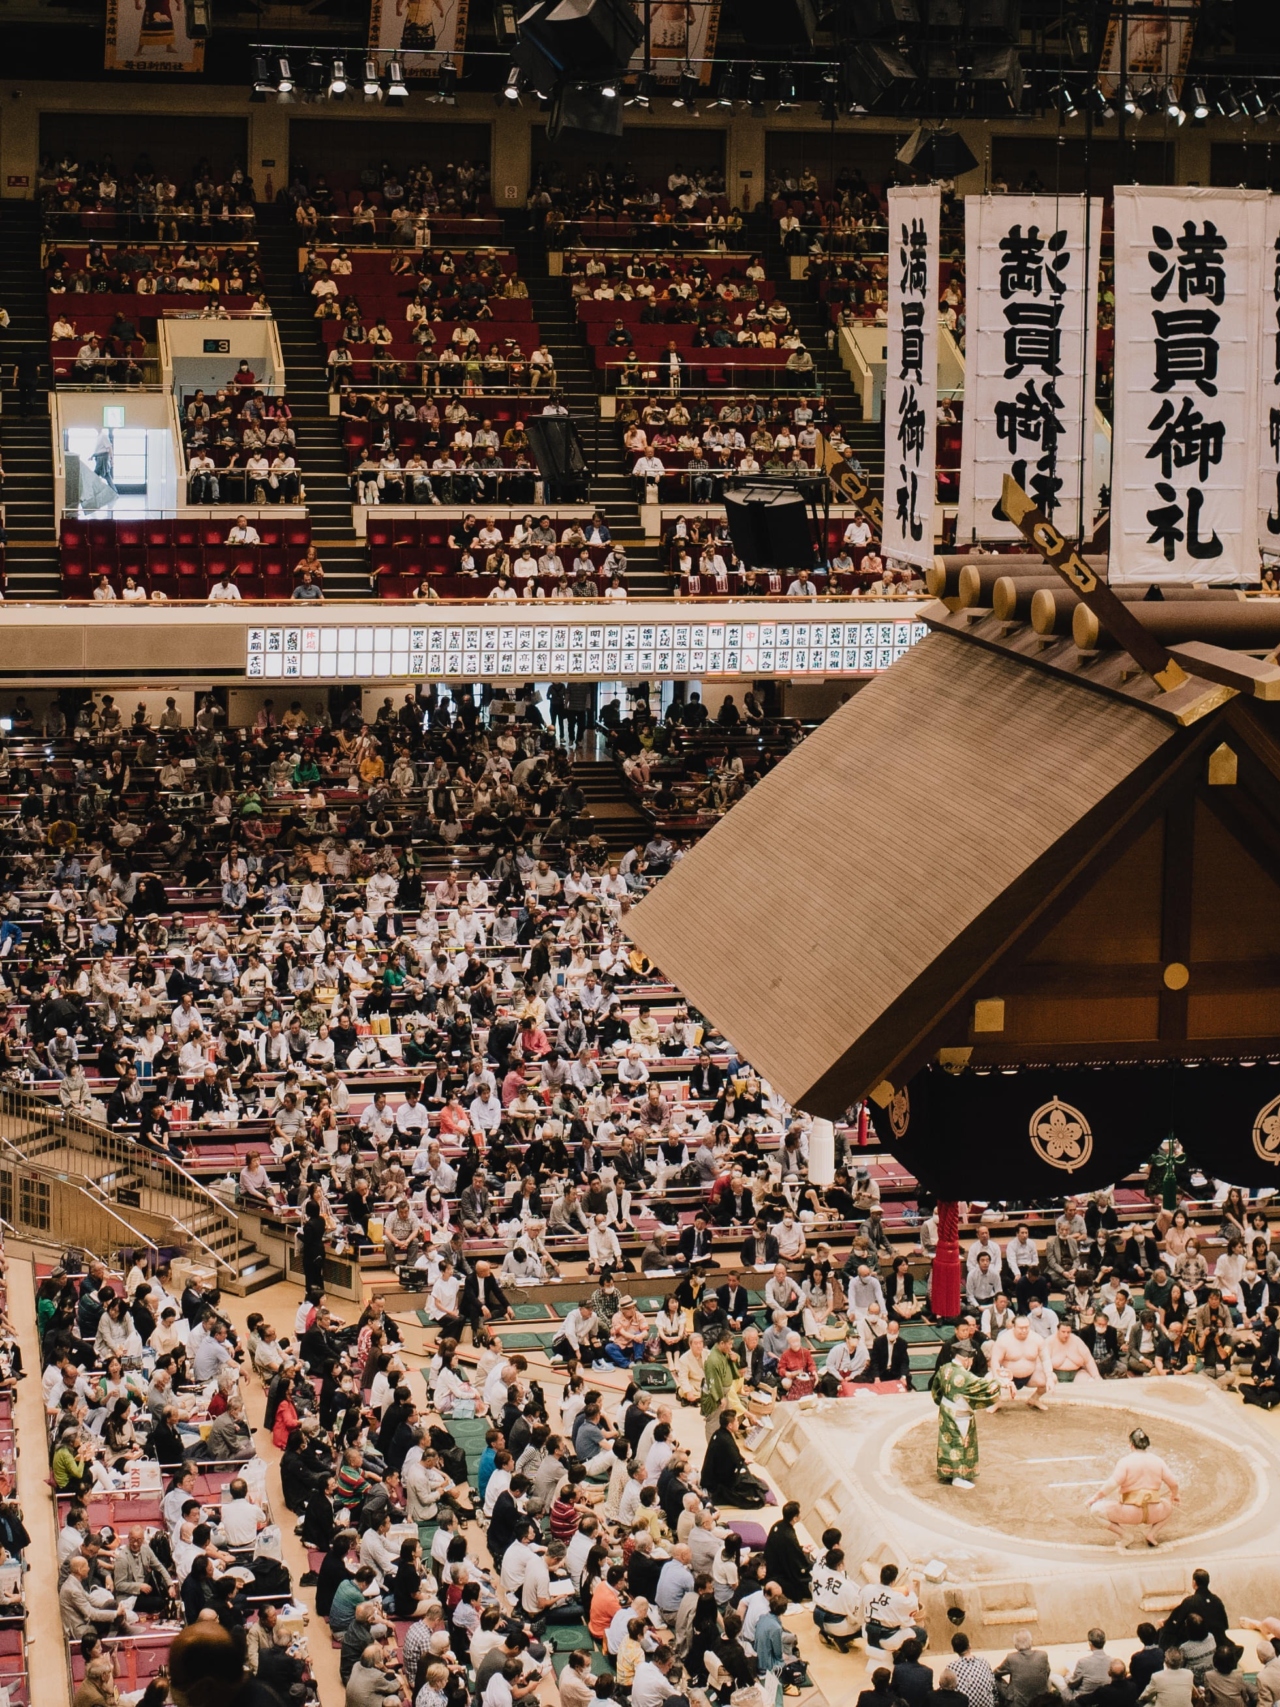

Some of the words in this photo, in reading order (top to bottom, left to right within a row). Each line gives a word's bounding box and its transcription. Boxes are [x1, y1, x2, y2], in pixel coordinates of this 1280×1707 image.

[897, 217, 927, 541] 満員御礼
[1145, 219, 1227, 561] 満員御礼
[502, 630, 513, 649] 正代
[624, 629, 636, 648] 一山本
[131, 1468, 140, 1500] KIRN
